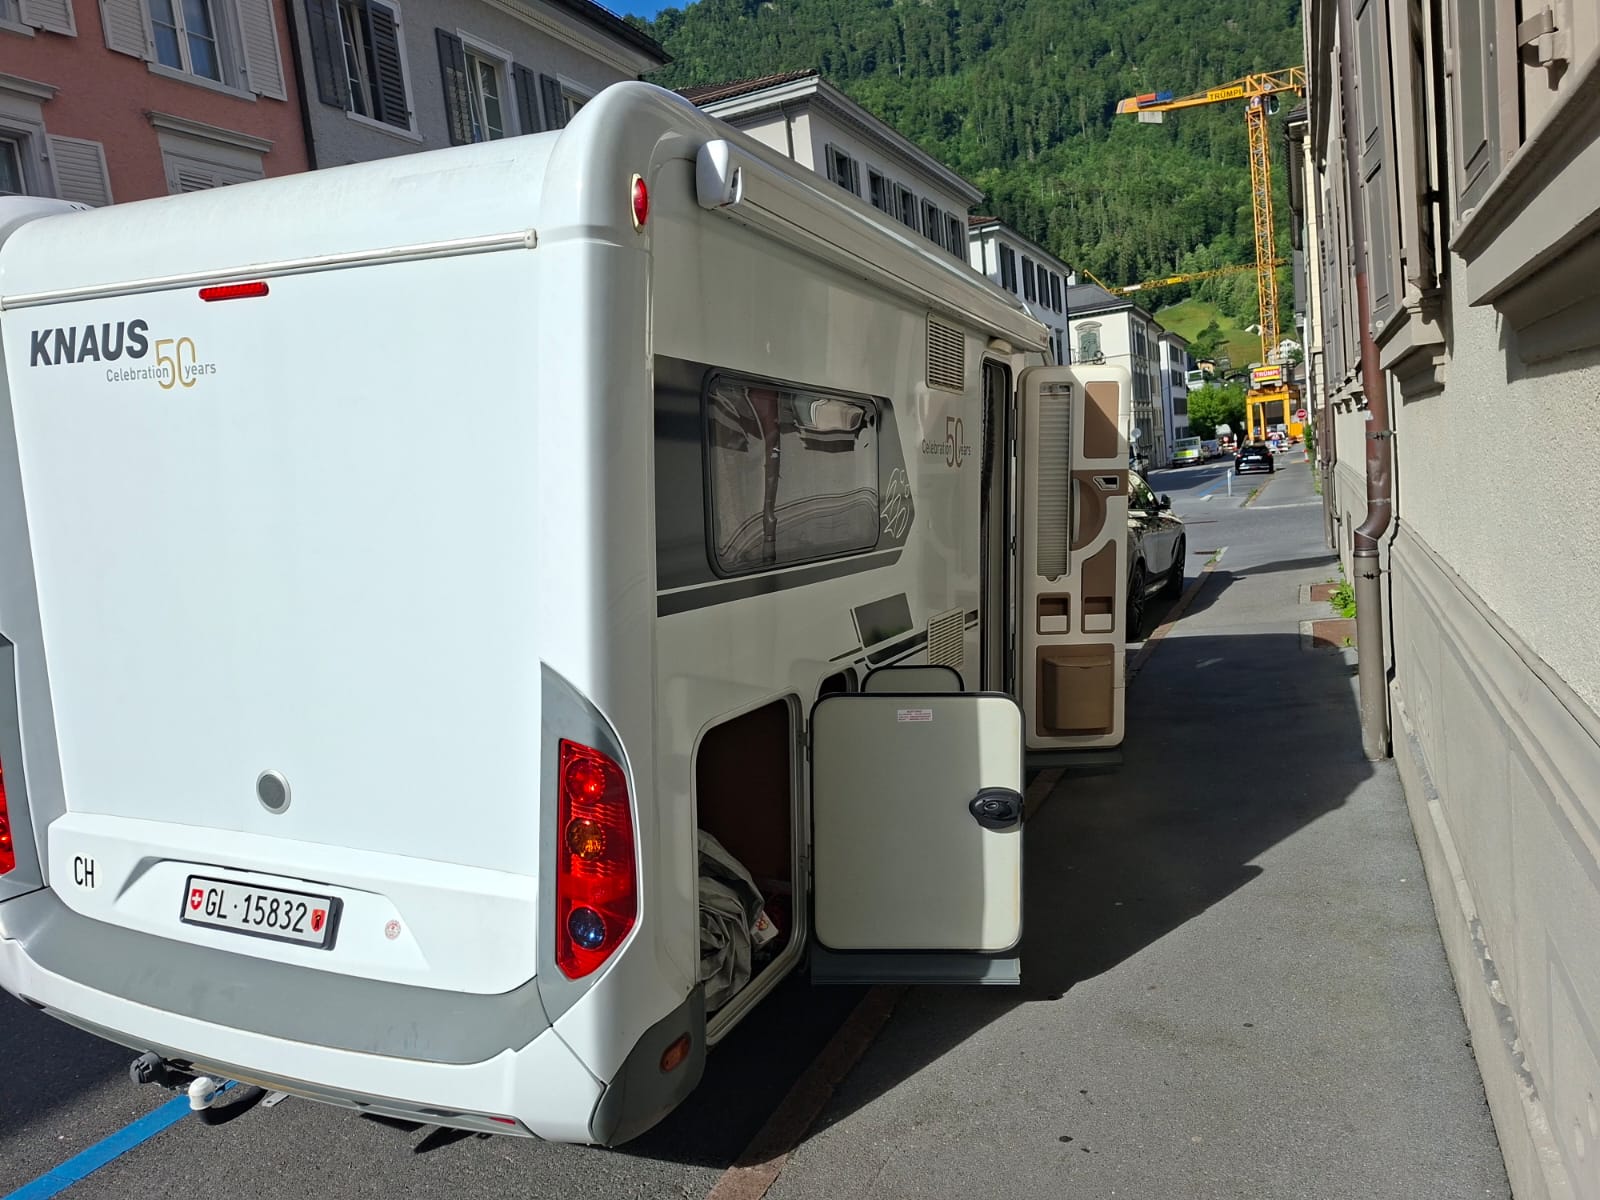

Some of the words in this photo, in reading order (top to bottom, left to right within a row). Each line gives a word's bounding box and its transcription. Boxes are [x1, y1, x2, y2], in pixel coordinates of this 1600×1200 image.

[30, 319, 149, 367] KNAUS
[106, 363, 169, 382] Celebration
[155, 336, 197, 390] 50
[184, 363, 217, 379] years
[946, 416, 964, 468] 50
[74, 856, 95, 889] CH
